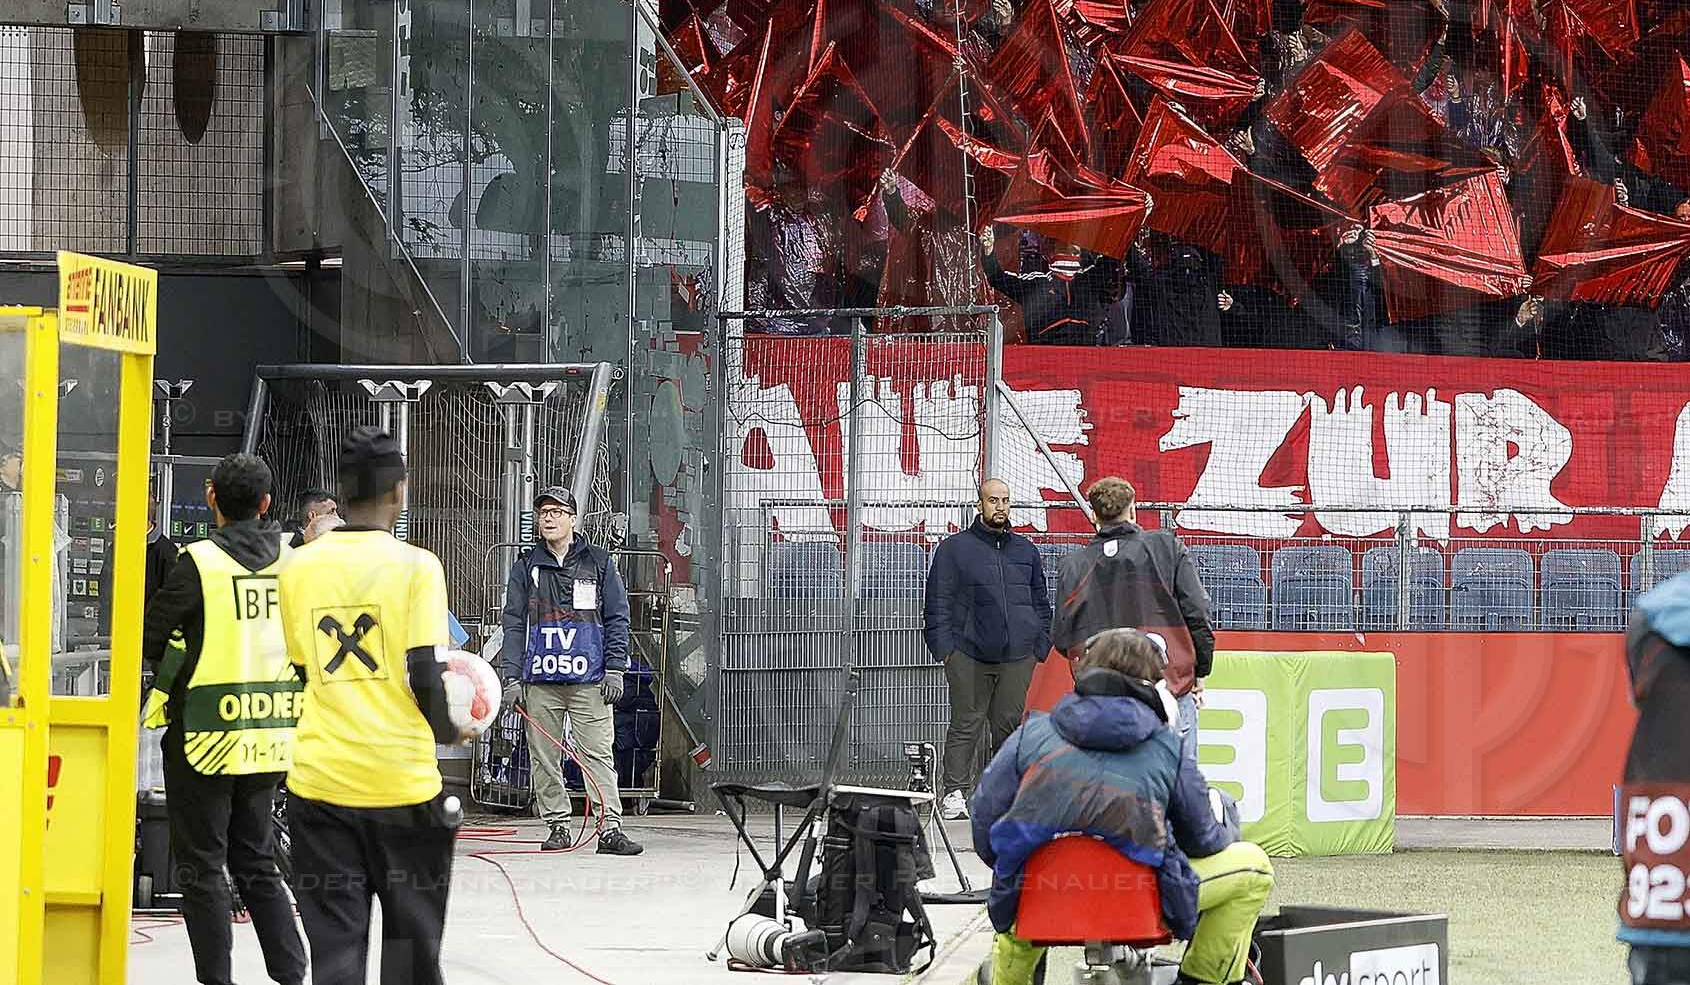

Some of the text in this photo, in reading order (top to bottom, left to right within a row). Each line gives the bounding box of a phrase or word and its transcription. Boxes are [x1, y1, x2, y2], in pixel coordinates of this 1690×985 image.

[93, 267, 150, 343] FANBANK
[727, 374, 1094, 543] AUF
[1159, 385, 1574, 546] ZUR
[541, 627, 578, 651] TV
[531, 655, 589, 676] 2050
